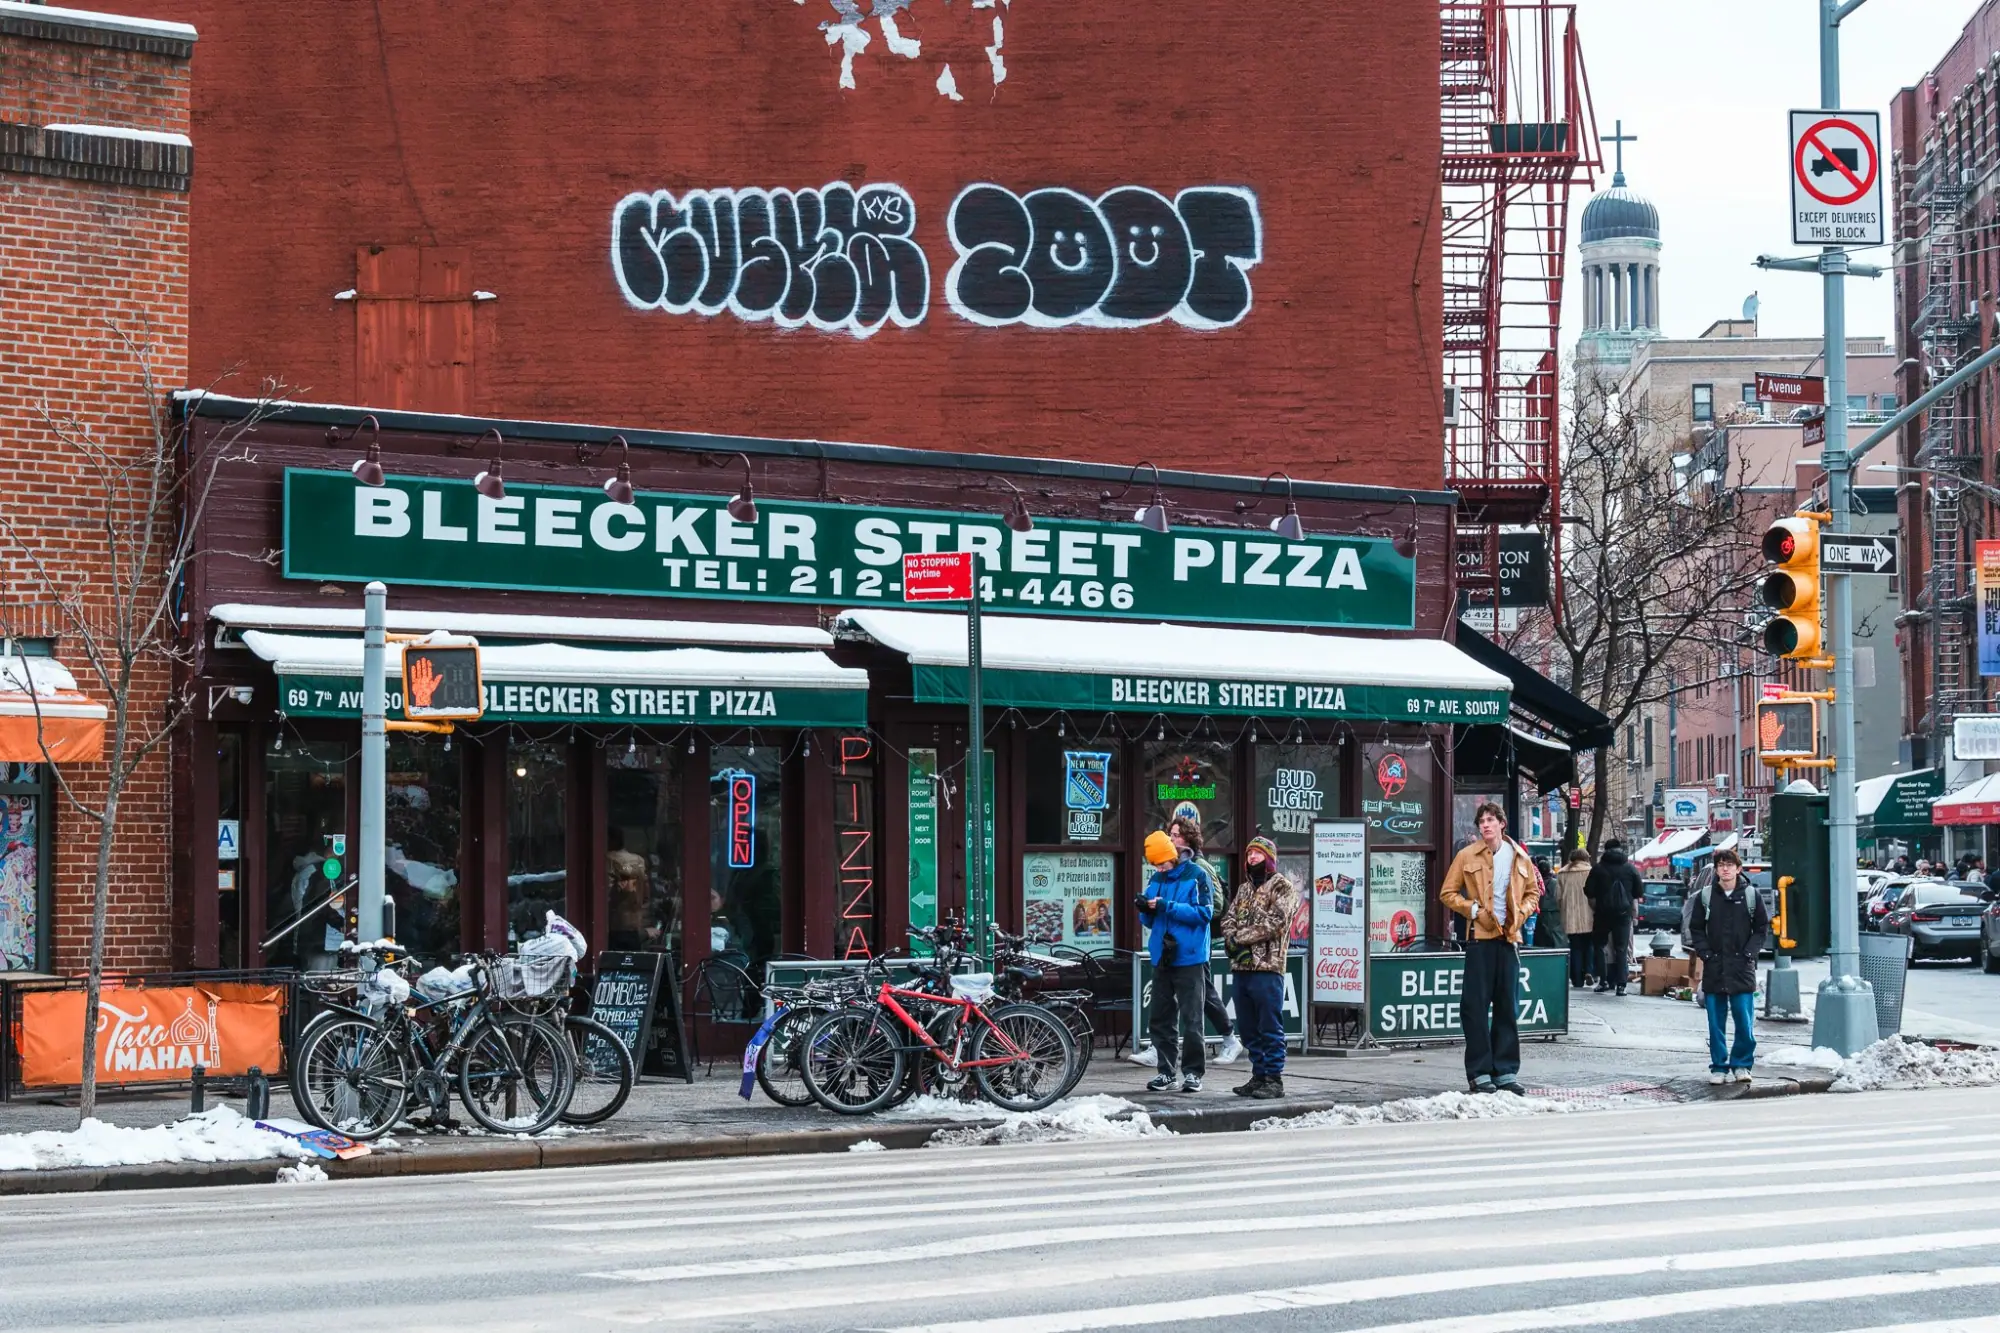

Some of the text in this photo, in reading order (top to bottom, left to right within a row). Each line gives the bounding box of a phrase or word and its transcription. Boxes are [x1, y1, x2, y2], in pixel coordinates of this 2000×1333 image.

[861, 194, 904, 223] KYS
[1799, 211, 1877, 224] EXCEPT DELIVERIES
[1810, 226, 1866, 239] THIS BLOCK
[1758, 378, 1802, 395] 7 Avenue
[354, 485, 1368, 592] BLEECKER STREET PIZZA
[907, 557, 960, 568] NO STOPPING
[1829, 546, 1886, 563] ONE WAY
[908, 569, 942, 581] Anytime
[663, 558, 1135, 610] TEL: 212-4-4466
[1985, 612, 1998, 623] BE
[288, 689, 308, 707] 69
[314, 690, 332, 708] 7th
[338, 691, 364, 709] AV
[610, 688, 699, 716] STREET
[710, 690, 777, 716] PIZZA
[1112, 678, 1347, 710] BLEECKER STREET PIZZA
[1407, 698, 1500, 715] 69 7th AVE. SOUTH
[1070, 760, 1105, 770] NEW YORK
[1075, 772, 1103, 803] RANGERS
[1276, 768, 1316, 790] BUD
[1158, 783, 1216, 800] Heineken
[1268, 788, 1323, 811] LIGHT
[733, 779, 752, 863] OPEN
[1074, 813, 1096, 823] BUD
[1392, 819, 1424, 829] LIGHT
[218, 825, 234, 848] A
[1069, 823, 1099, 834] LIGHT
[841, 737, 873, 960] PIZZA
[1331, 851, 1345, 859] Pizza
[1060, 858, 1077, 868] Rated
[1078, 858, 1108, 868] America's
[1377, 864, 1394, 878] Here
[1057, 872, 1065, 882] #2
[1066, 871, 1090, 882] Pizzeria
[1090, 872, 1097, 882] in
[1064, 886, 1105, 897] by TripAdvisor
[1320, 947, 1358, 957] ICE COLD
[594, 981, 637, 1006] COMBO
[1316, 980, 1363, 991] SOLD HERE
[1380, 1002, 1461, 1032] STREE
[96, 1001, 170, 1072] Taco
[115, 1045, 211, 1072] MAHAL
